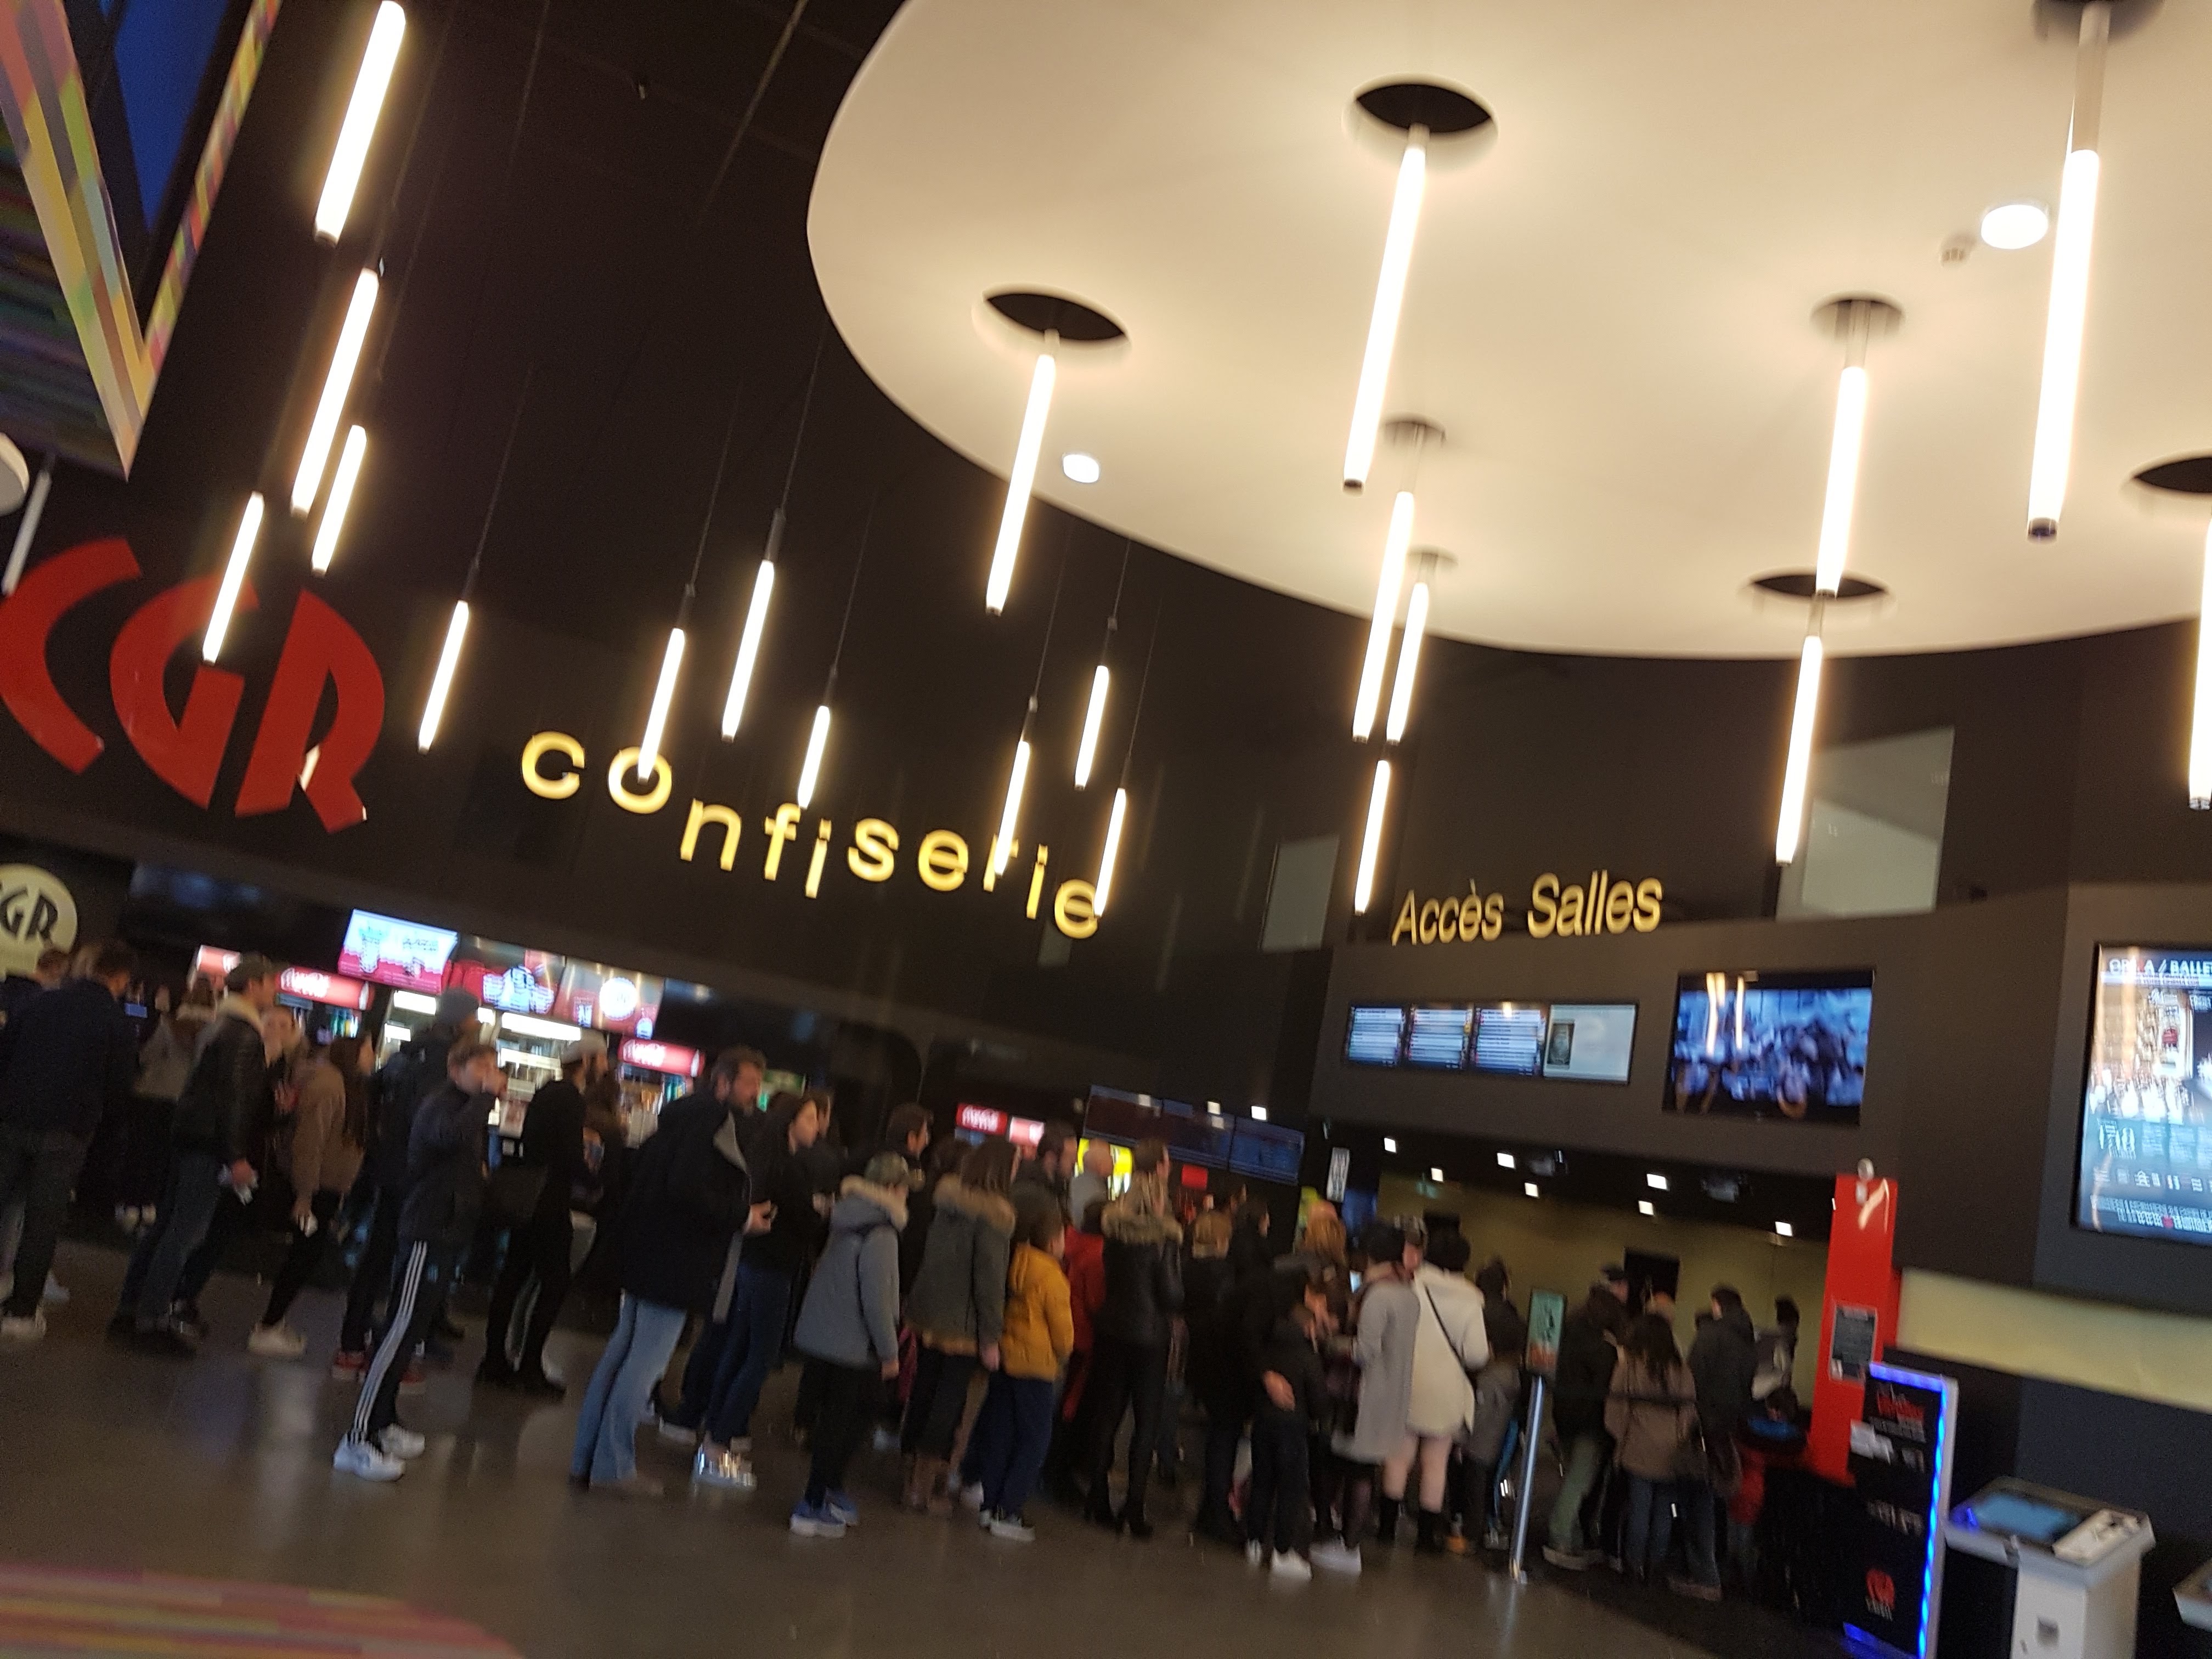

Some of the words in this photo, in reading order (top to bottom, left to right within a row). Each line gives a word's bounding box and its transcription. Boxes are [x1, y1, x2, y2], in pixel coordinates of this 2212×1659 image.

[0, 538, 385, 832] CGR
[0, 884, 59, 943] GR
[1391, 878, 1504, 946] Accès
[1527, 869, 1663, 939] Salles
[2170, 960, 2212, 978] BALLE
